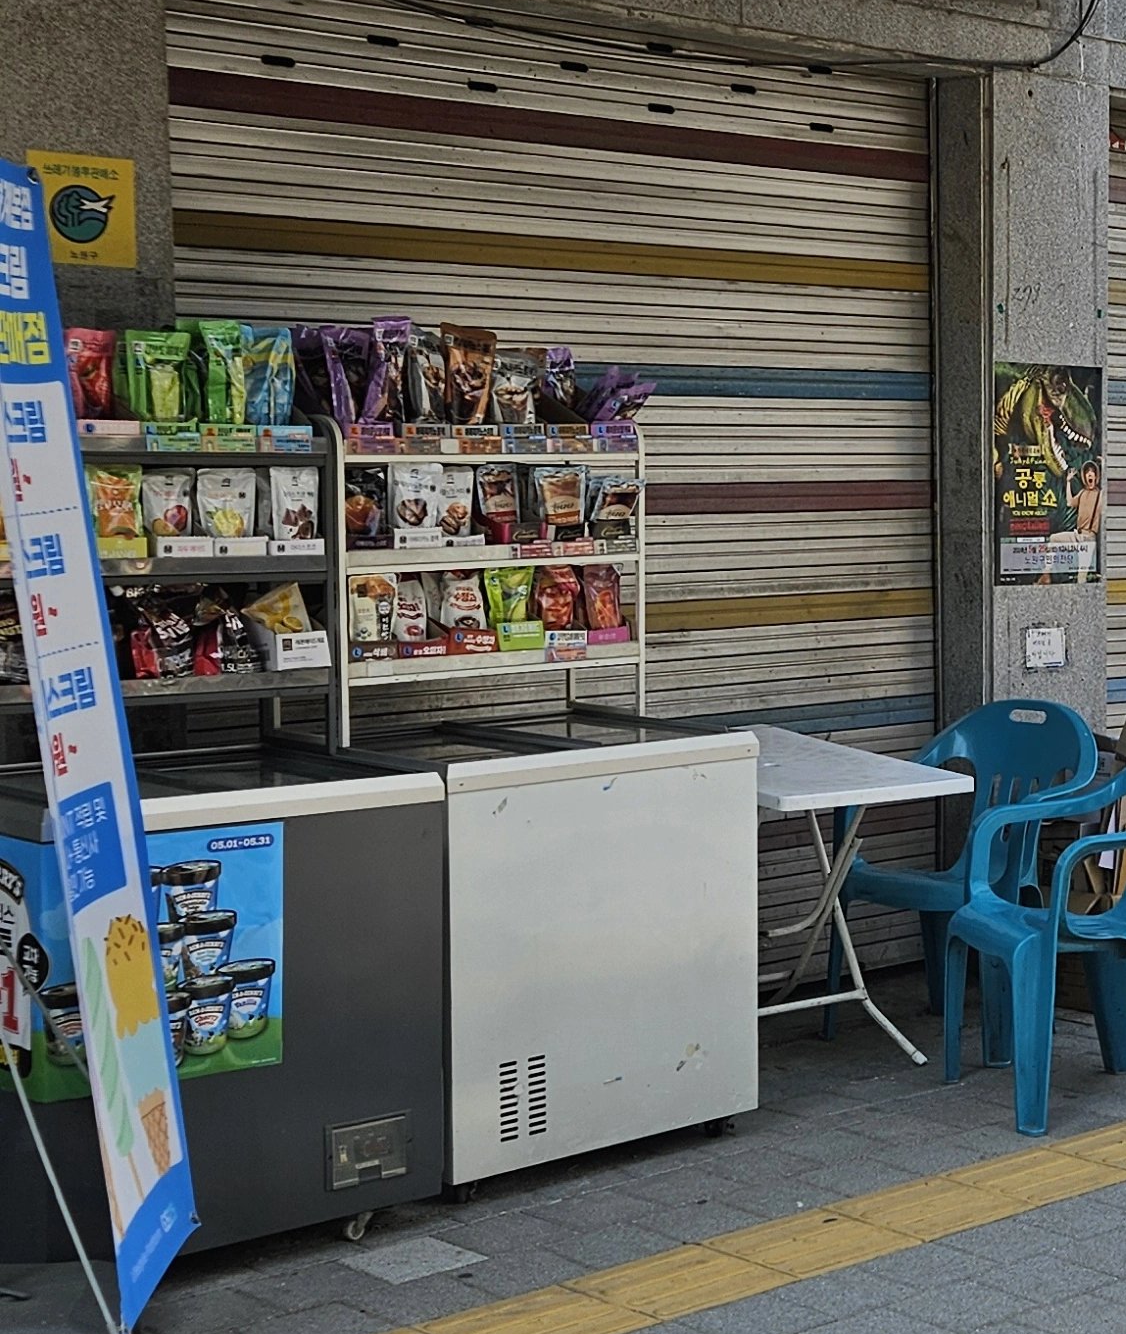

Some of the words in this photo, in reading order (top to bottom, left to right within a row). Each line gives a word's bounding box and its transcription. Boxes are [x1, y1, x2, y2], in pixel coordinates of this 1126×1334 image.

[1015, 468, 1047, 489] 공룡
[1003, 490, 1039, 508] 애니멀
[1040, 488, 1058, 508] 쇼
[210, 835, 272, 851] 05.01-05.31
